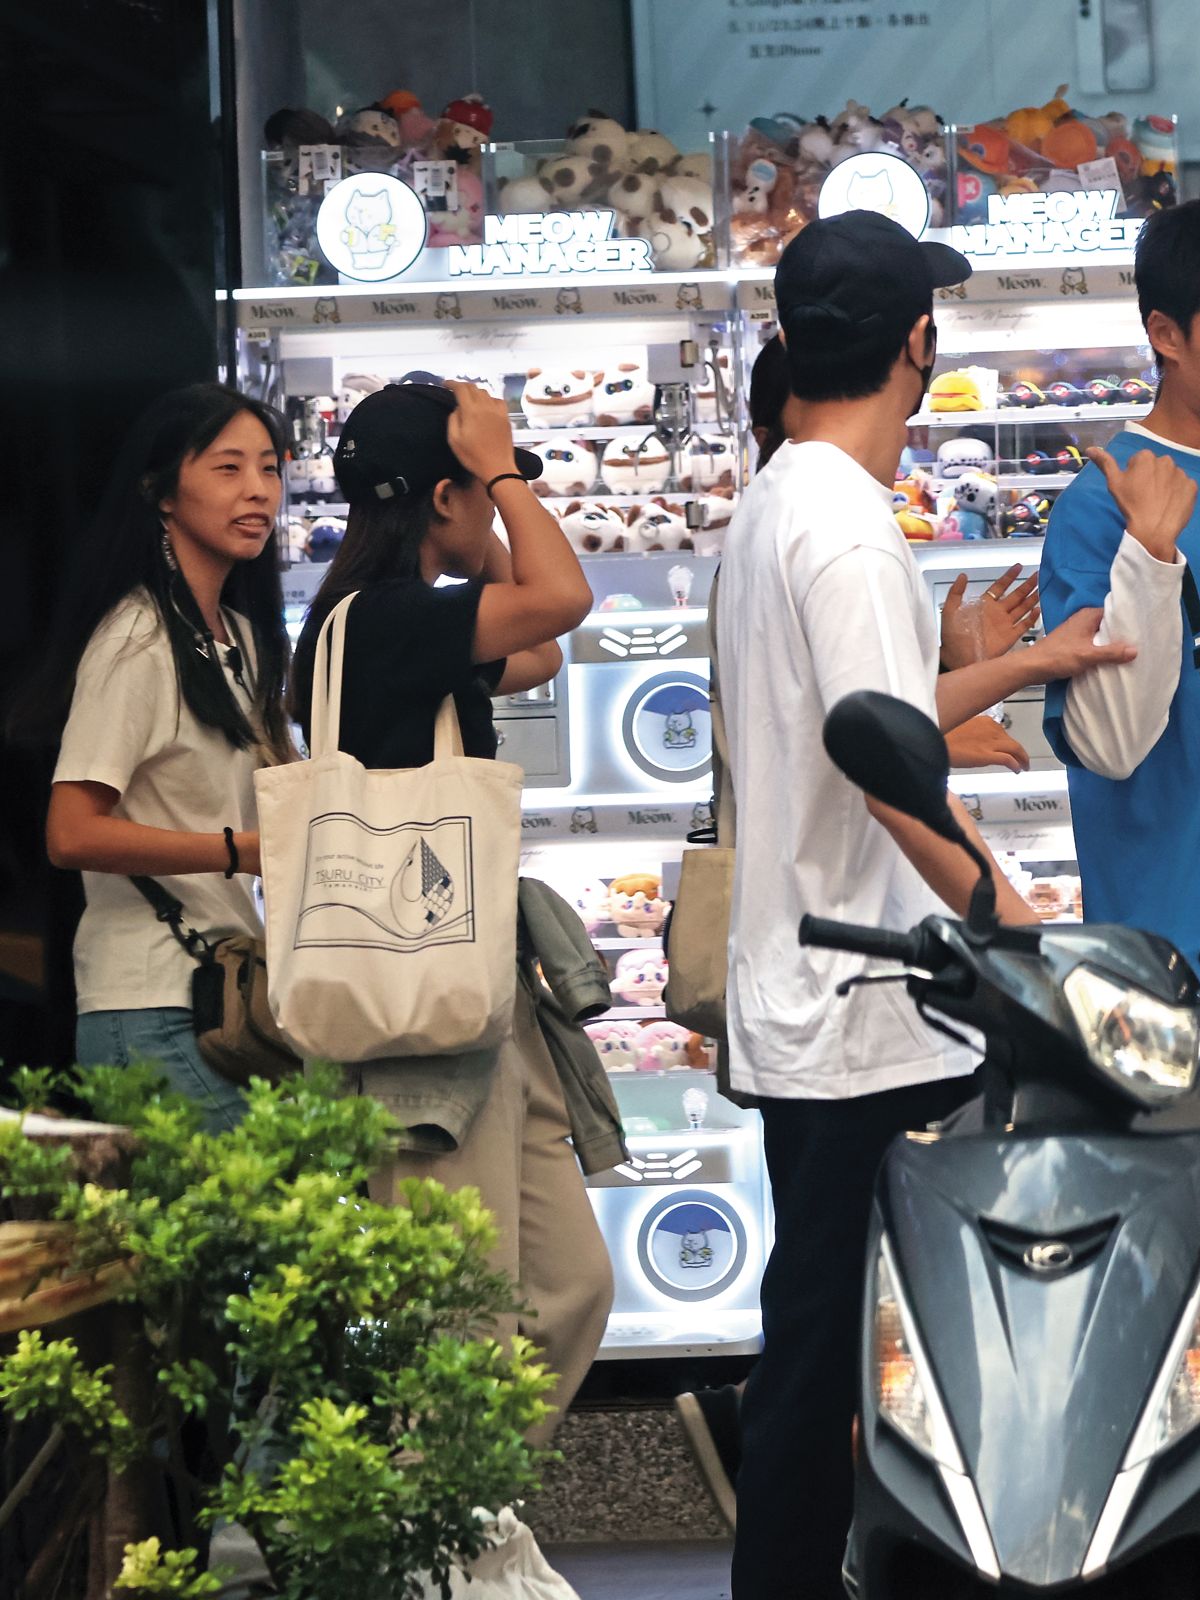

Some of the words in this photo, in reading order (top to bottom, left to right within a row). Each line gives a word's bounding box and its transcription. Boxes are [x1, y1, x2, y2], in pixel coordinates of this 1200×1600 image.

[987, 189, 1118, 224] MEOW
[483, 210, 616, 245] MEOW
[448, 237, 655, 276] MANAGER
[521, 815, 556, 829] eow.
[316, 868, 353, 882] TSURU
[358, 873, 385, 887] CITY
